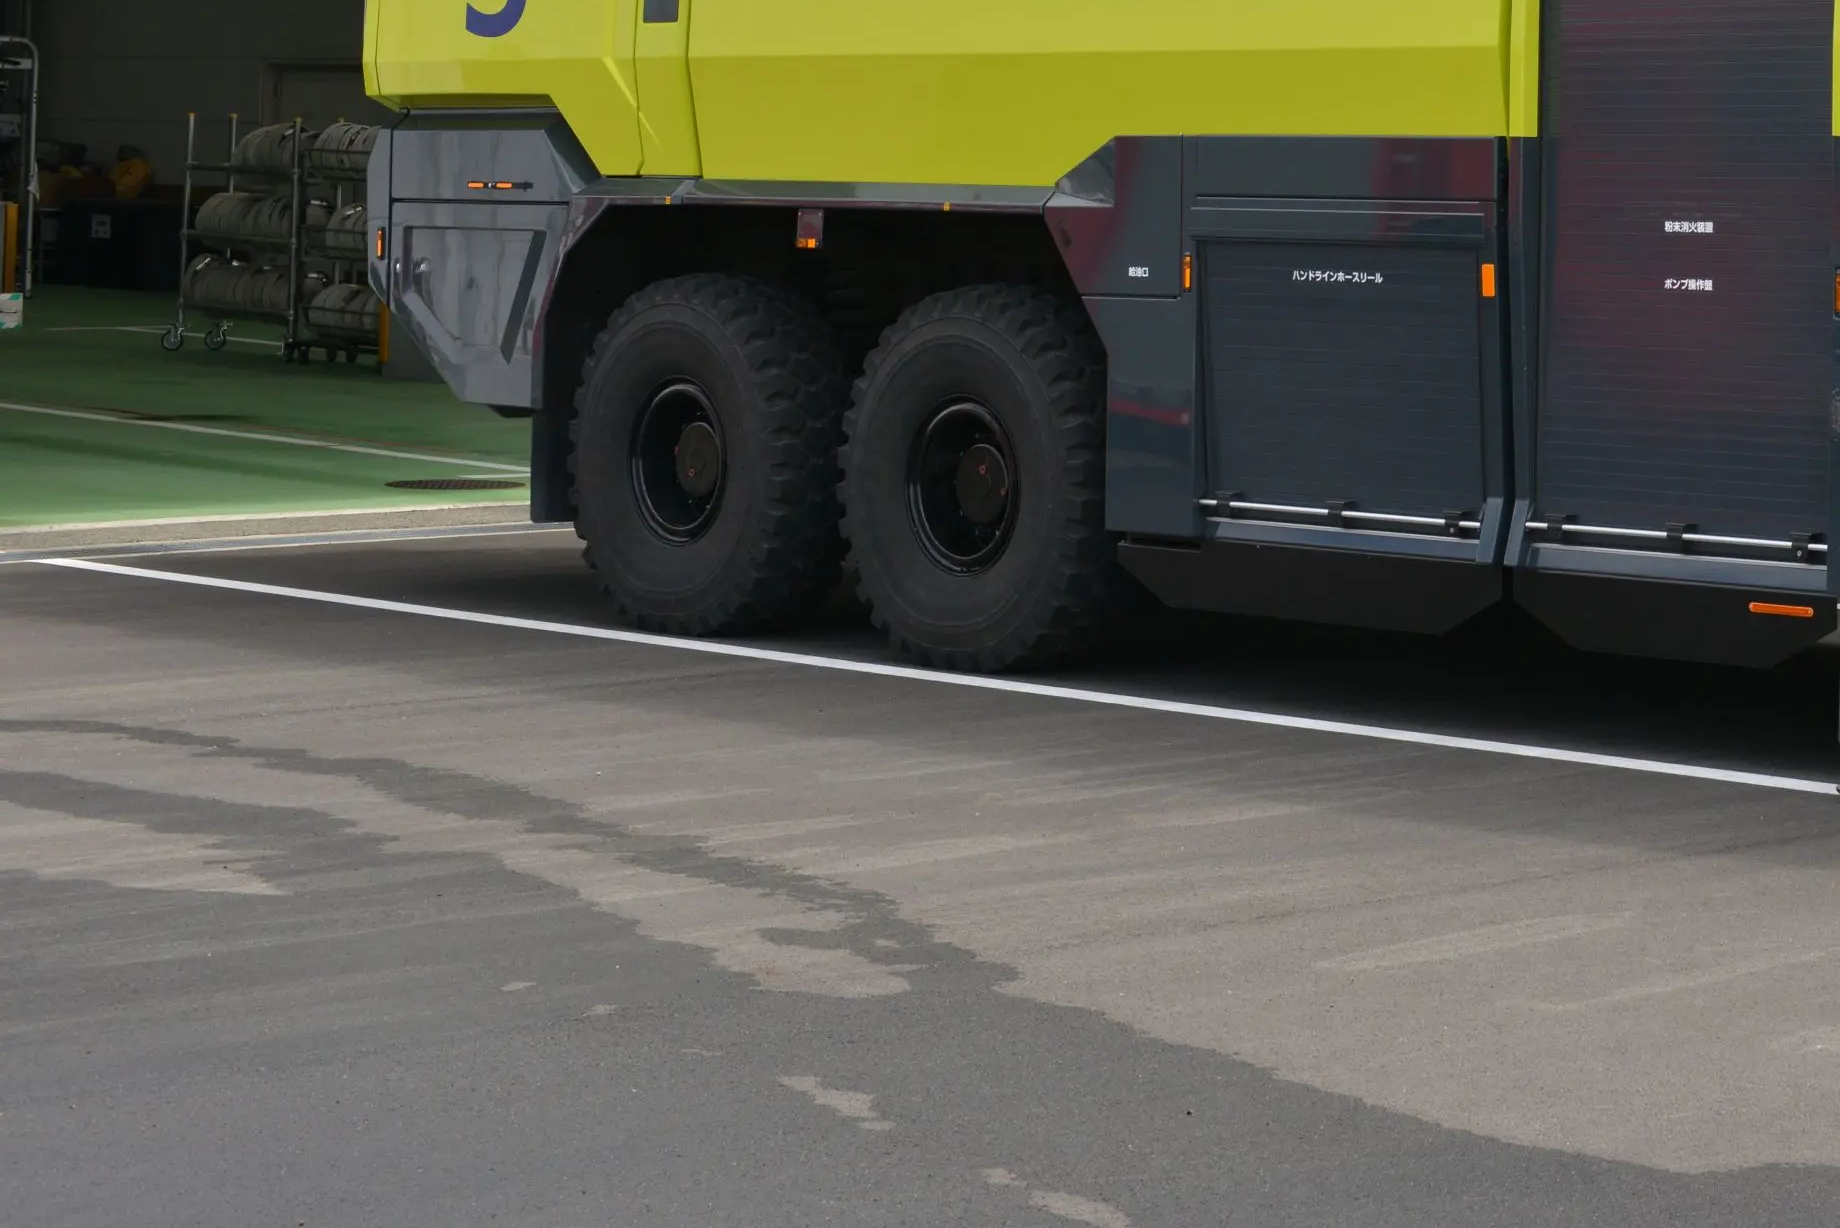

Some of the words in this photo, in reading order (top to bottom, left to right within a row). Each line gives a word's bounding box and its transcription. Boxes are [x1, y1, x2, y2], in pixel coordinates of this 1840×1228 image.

[1664, 220, 1714, 233] 粉末消火装置
[1128, 266, 1149, 277] 給油口
[1292, 270, 1384, 283] ハンドラインホースリール
[1664, 278, 1713, 291] ポンプ操作盤
